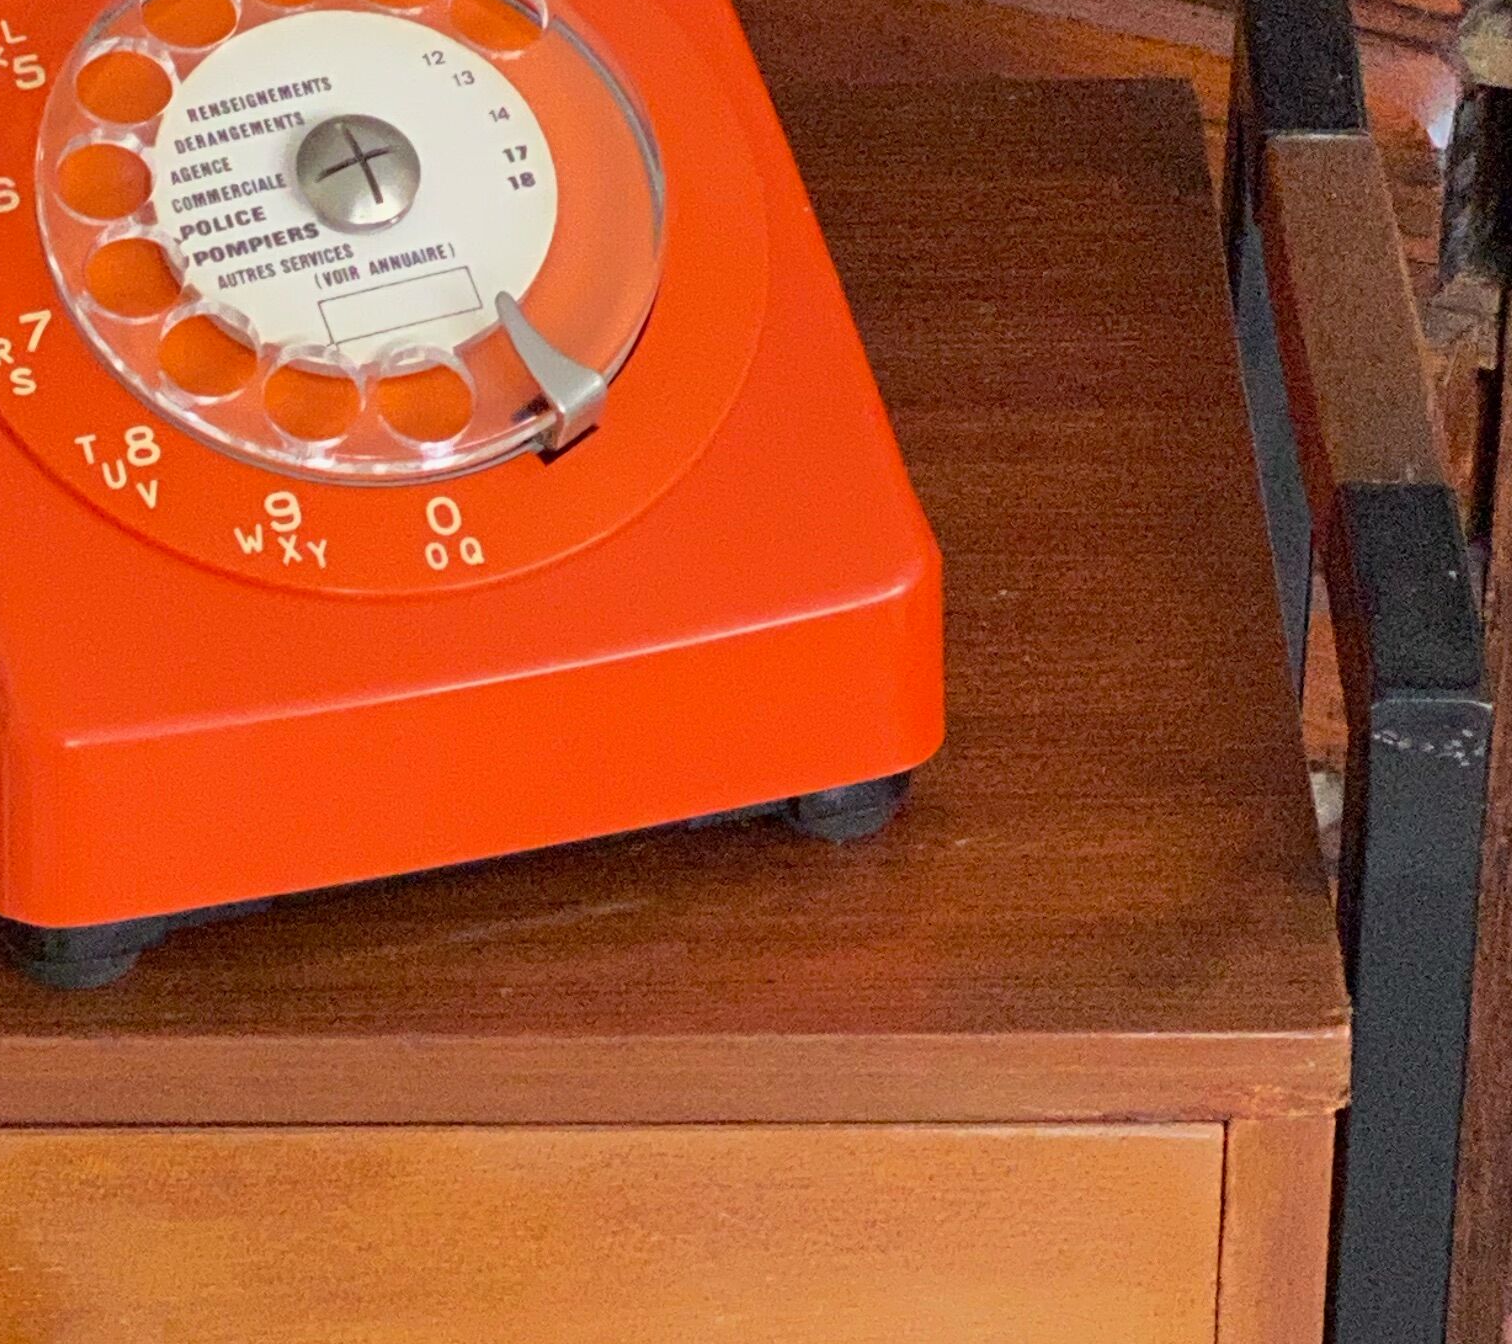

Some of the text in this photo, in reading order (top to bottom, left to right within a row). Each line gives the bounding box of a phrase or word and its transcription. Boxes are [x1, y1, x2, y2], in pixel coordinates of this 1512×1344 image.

[13, 54, 46, 90] 5
[422, 50, 446, 67] 12
[452, 70, 475, 87] 13
[186, 76, 332, 123] RENSEIGNEMENTS
[488, 106, 510, 123] 14
[174, 111, 305, 155] DERANGEMENTS
[170, 157, 232, 186] AGENCE
[502, 144, 528, 164] 17
[171, 173, 288, 214] COMMERCIALE
[507, 171, 536, 191] 18
[180, 206, 267, 241] POLICE
[192, 222, 320, 267] POMPIERS
[217, 243, 355, 290] AUTRES SERVICES
[314, 242, 456, 290] (VOIR ANNUAIRE)
[19, 309, 52, 353] 7
[124, 425, 161, 466] 8
[264, 491, 302, 532] 9
[425, 496, 462, 536] 0
